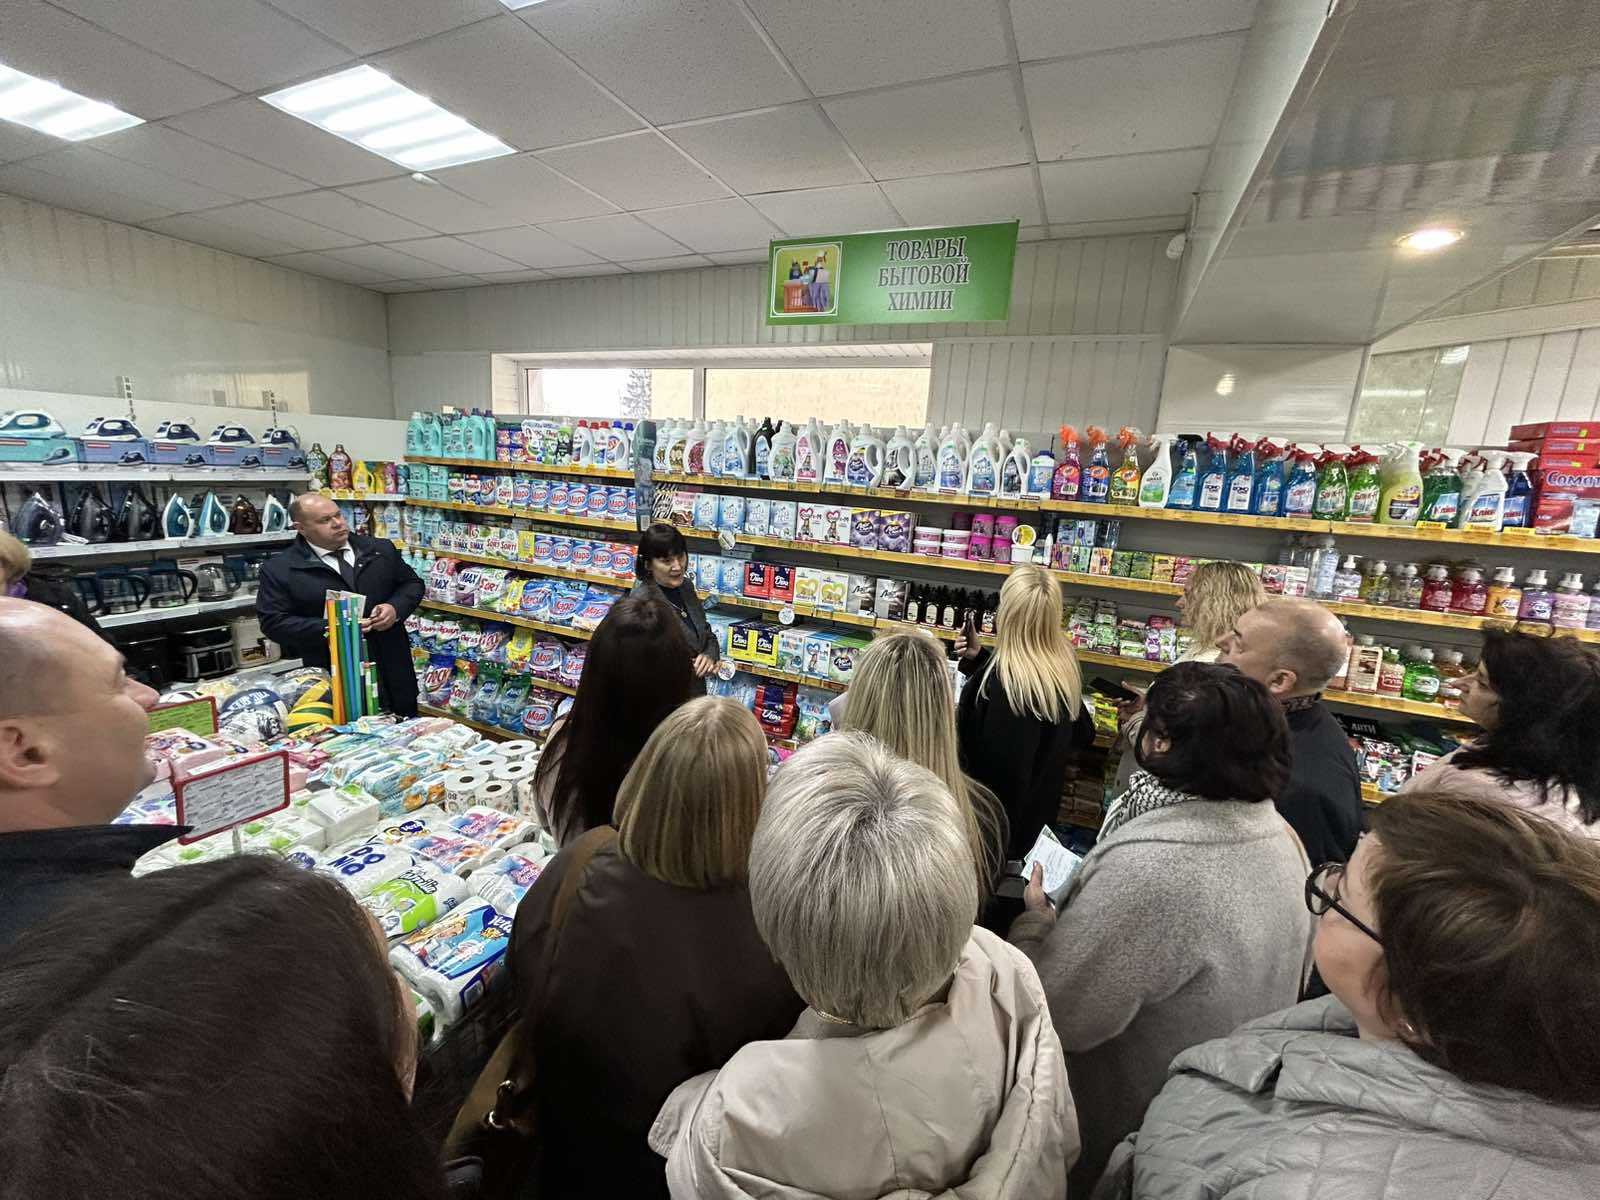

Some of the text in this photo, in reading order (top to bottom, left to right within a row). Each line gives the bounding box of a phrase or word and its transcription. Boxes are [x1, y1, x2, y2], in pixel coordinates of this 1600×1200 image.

[887, 237, 967, 261] ТОВАРЫ
[878, 258, 970, 287] БЫТОВОЙ
[888, 290, 955, 311] ХИМИИ
